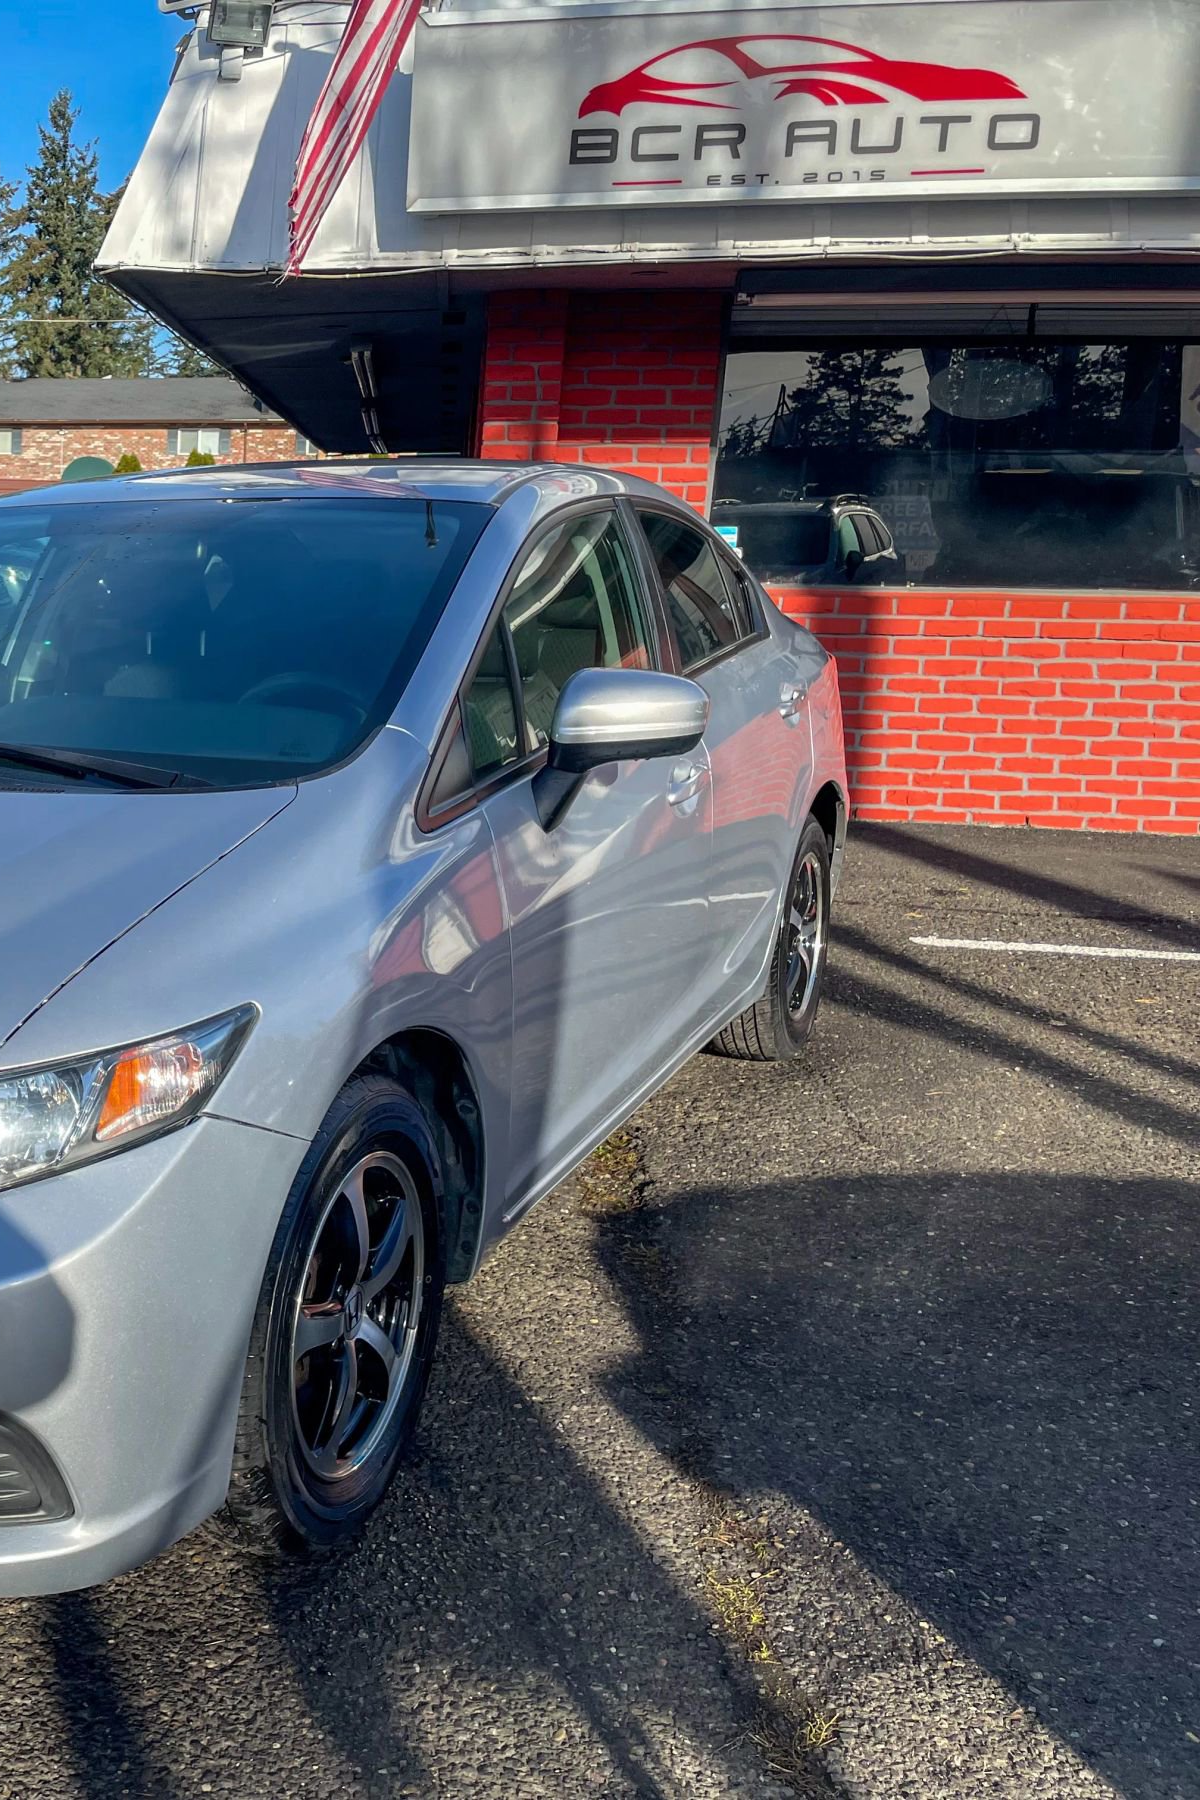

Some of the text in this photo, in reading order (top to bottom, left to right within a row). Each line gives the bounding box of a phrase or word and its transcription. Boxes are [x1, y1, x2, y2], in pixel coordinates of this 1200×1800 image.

[569, 113, 1041, 165] BCR AUTO
[707, 170, 886, 186] EST. 2015
